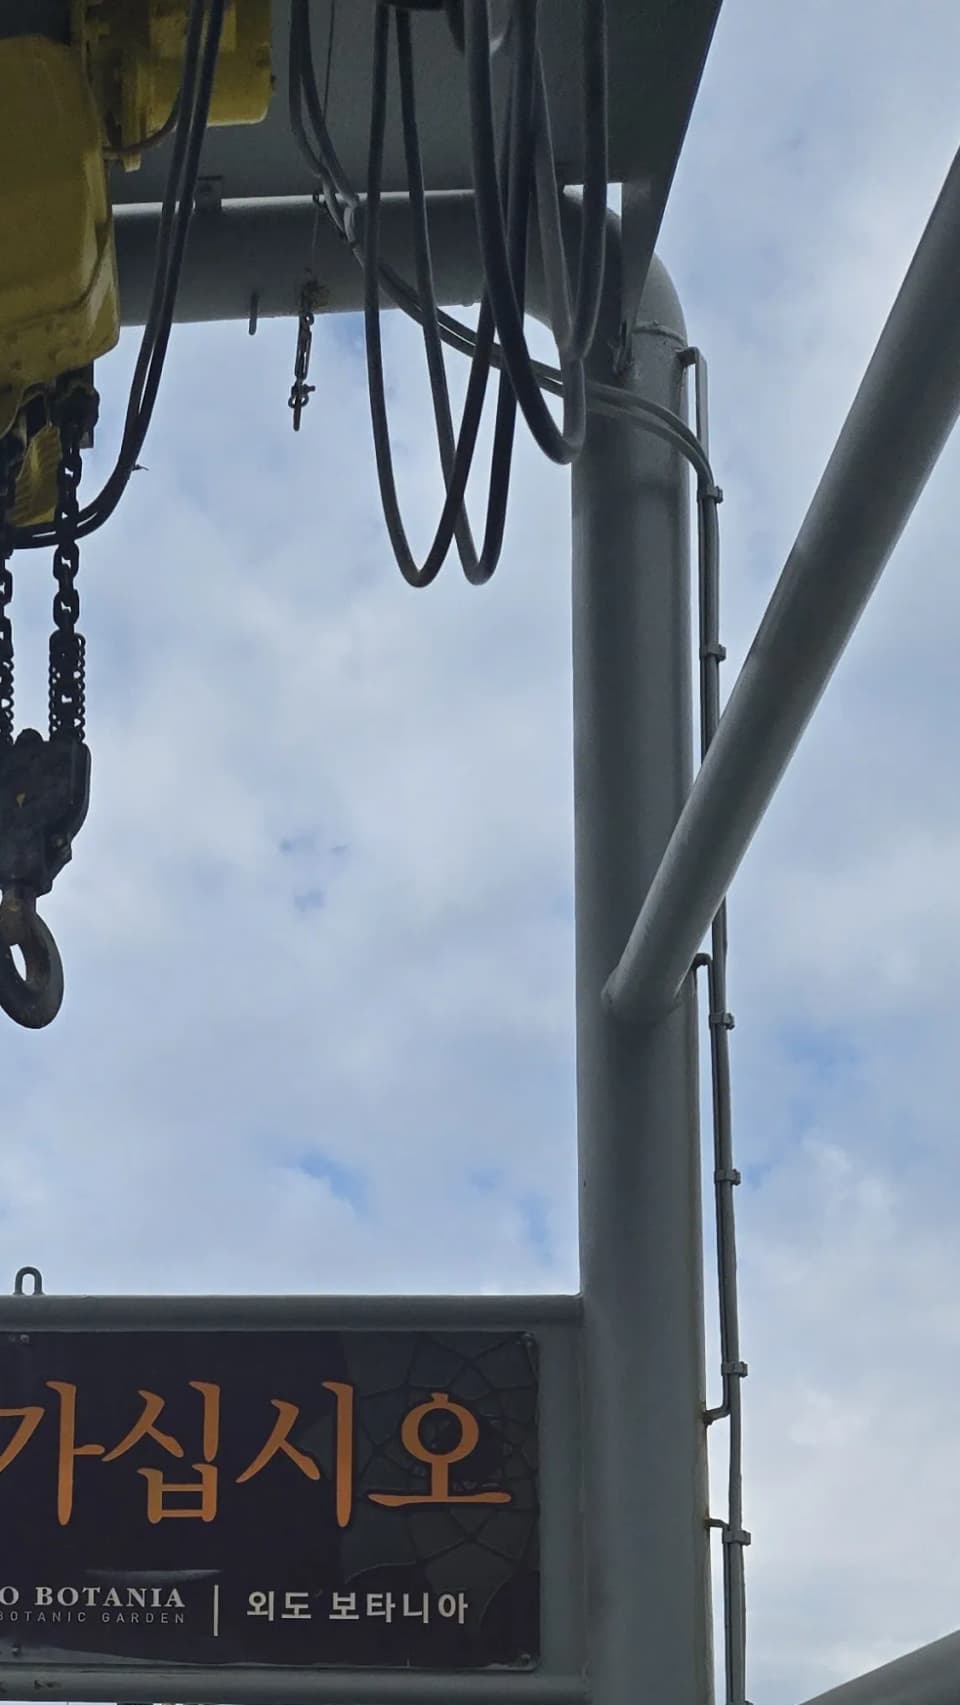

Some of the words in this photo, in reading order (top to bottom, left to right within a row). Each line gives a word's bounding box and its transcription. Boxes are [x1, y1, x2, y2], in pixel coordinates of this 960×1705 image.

[34, 1586, 186, 1608] BOTANIA
[246, 1591, 313, 1622] 외도
[328, 1591, 469, 1625] 보타니아
[101, 1612, 185, 1625] GARDEN
